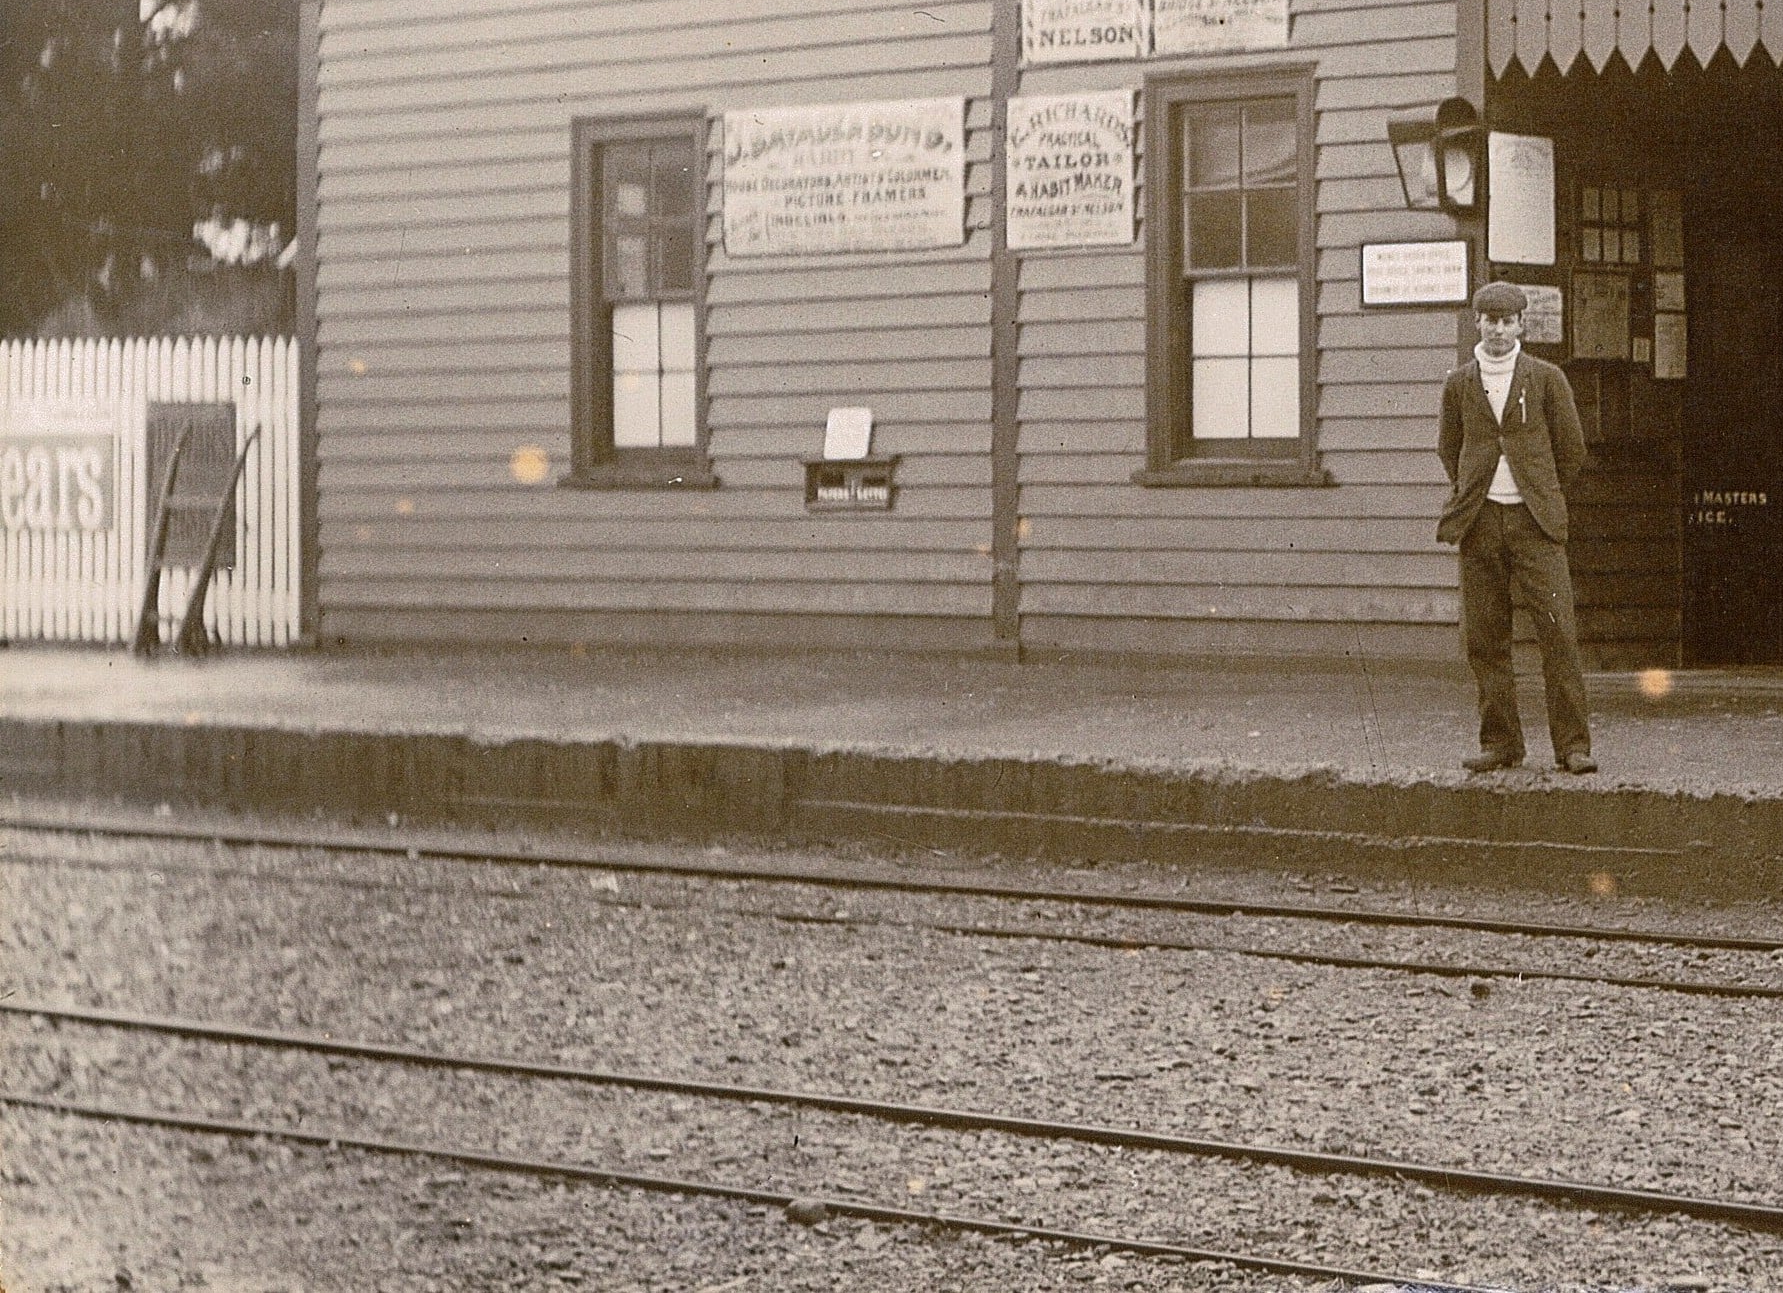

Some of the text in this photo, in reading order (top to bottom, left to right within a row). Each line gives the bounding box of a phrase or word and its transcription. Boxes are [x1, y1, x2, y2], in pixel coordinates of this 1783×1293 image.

[1039, 25, 1133, 48] NELSON
[1025, 153, 1109, 171] TAILOR
[1074, 172, 1123, 195] MAKER
[1, 445, 103, 531] ears
[1702, 490, 1768, 506] MASTERS
